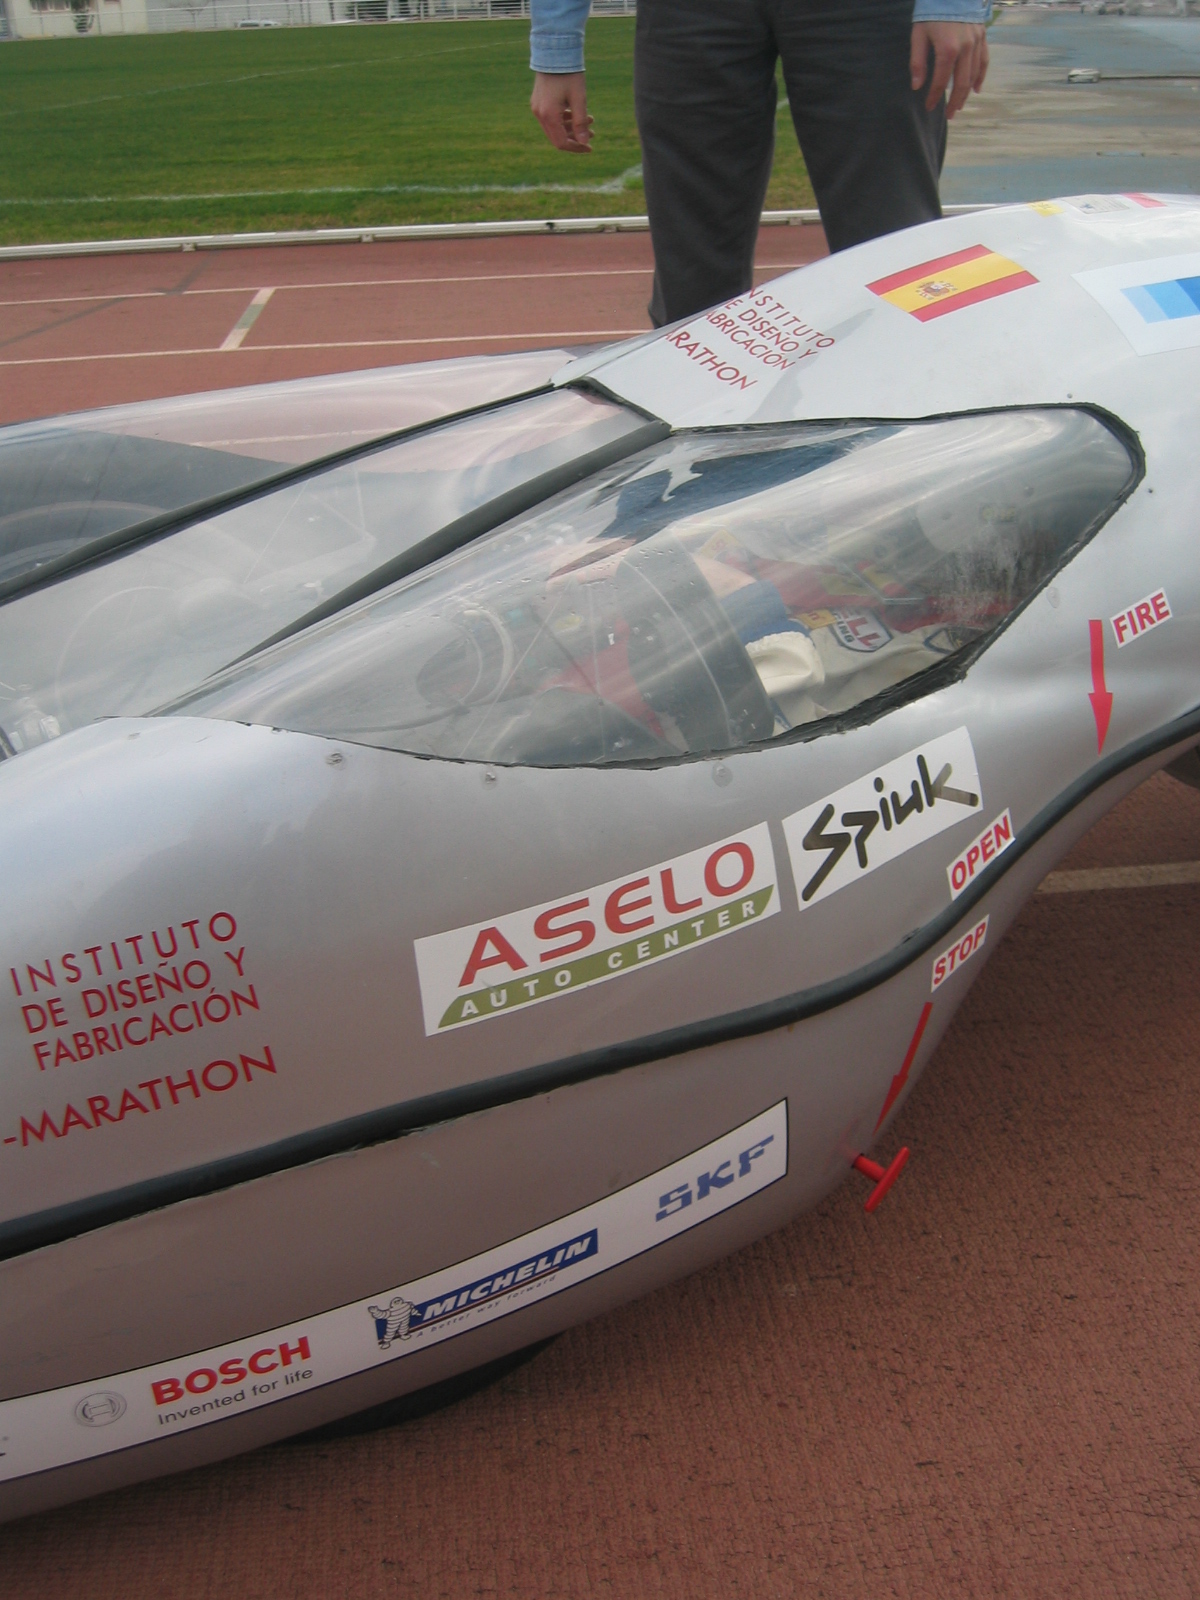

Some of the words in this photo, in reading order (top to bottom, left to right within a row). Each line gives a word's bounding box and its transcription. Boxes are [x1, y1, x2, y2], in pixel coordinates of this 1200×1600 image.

[737, 308, 799, 353] DISEÑO
[798, 348, 818, 359] Y
[1112, 592, 1170, 643] FIRE
[951, 815, 1012, 890] OPEN
[10, 911, 237, 996] INSTITUTO
[458, 841, 755, 988] ASELO
[932, 922, 987, 985] STOP
[22, 997, 68, 1034] DE
[82, 960, 211, 1018] DISEÑO
[224, 946, 245, 977] Y
[459, 969, 572, 1019] AUTO
[607, 901, 756, 970] CENTER
[33, 986, 260, 1071] FABRICACIÓN
[655, 1134, 774, 1222] SKF
[423, 1236, 592, 1321] MICHELIN
[430, 1312, 470, 1332] better
[477, 1300, 500, 1316] way
[507, 1274, 556, 1300] forward
[151, 1336, 311, 1405] BOSCH
[158, 1389, 246, 1425] Invented
[252, 1380, 278, 1397] for
[284, 1367, 313, 1386] life
